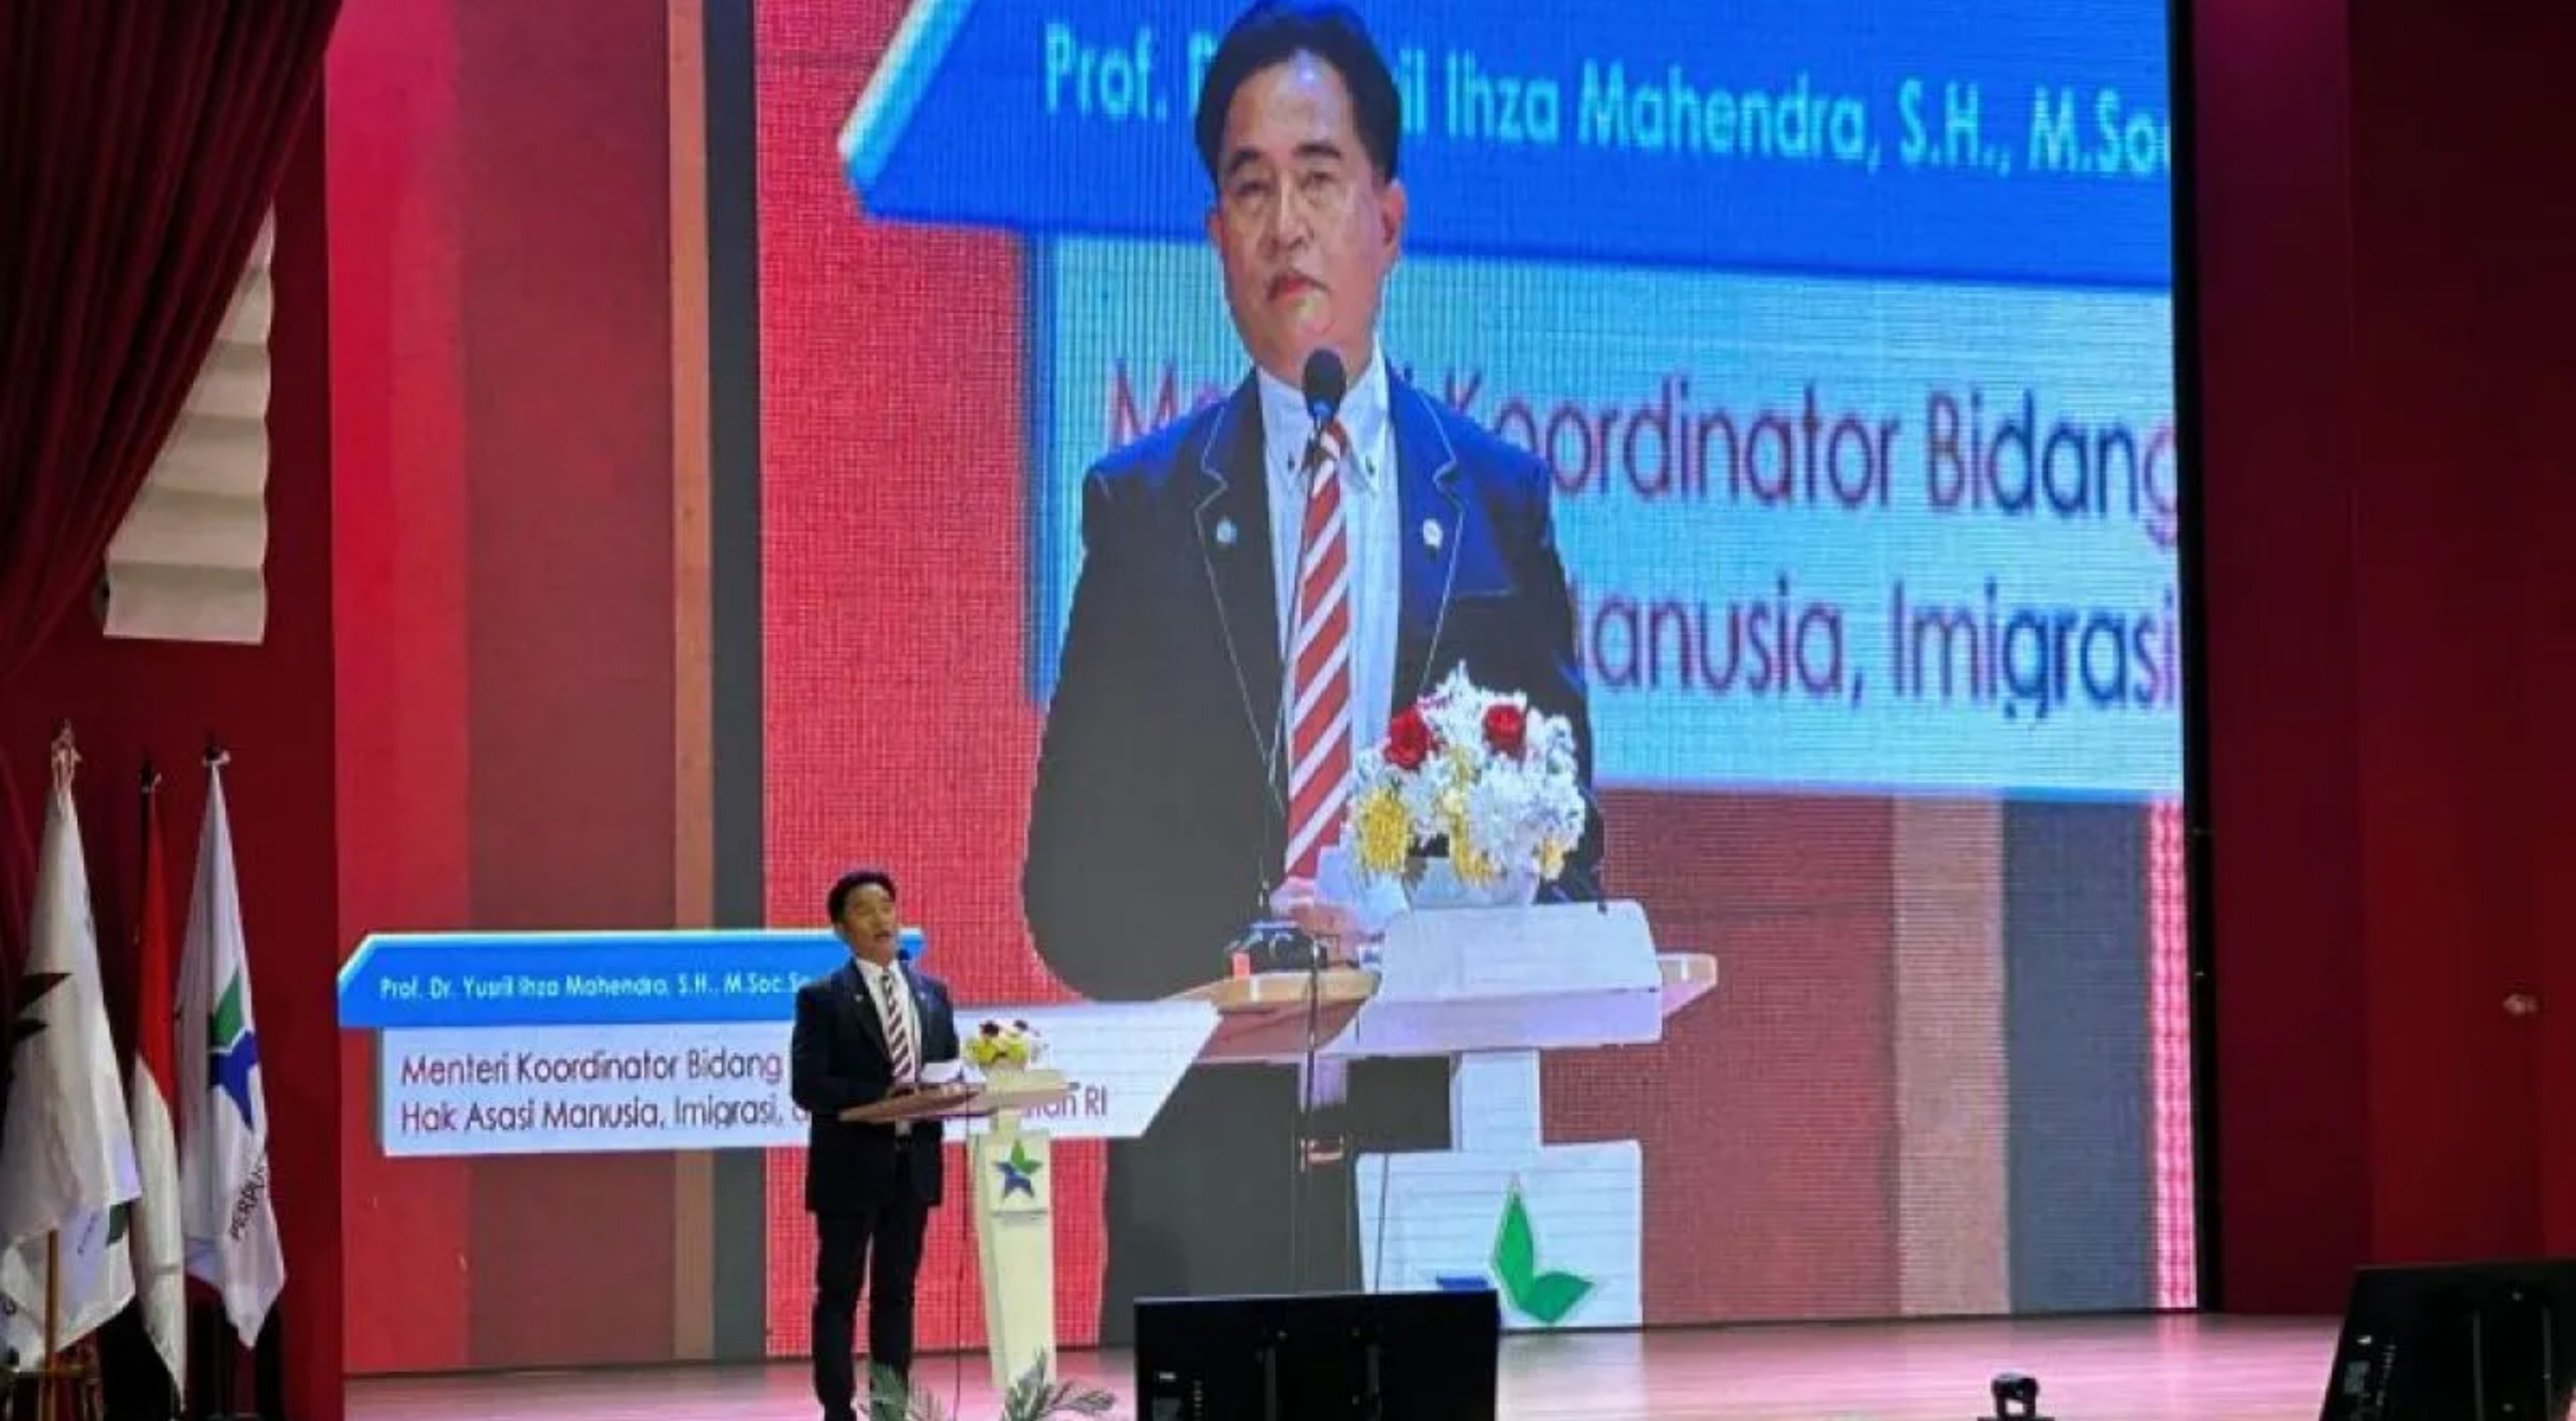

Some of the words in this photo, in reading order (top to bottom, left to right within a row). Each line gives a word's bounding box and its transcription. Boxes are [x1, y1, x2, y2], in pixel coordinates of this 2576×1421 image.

[1043, 21, 1168, 122] Prof.
[1446, 49, 1559, 144] Ihza
[1578, 58, 1881, 175] Mahendra,
[1899, 77, 2011, 177] S.H.,
[2028, 84, 2170, 177] M.So
[1569, 570, 1865, 710] anusia,
[402, 1053, 506, 1086] Menteri
[517, 1050, 677, 1083] Koordinator
[687, 1046, 783, 1085] Bidang
[402, 1102, 455, 1133] Hak
[464, 1100, 535, 1131] Asasi
[543, 1096, 665, 1129] Manusia,
[676, 1094, 783, 1130] Imigrasi,
[1084, 1085, 1107, 1117] RI
